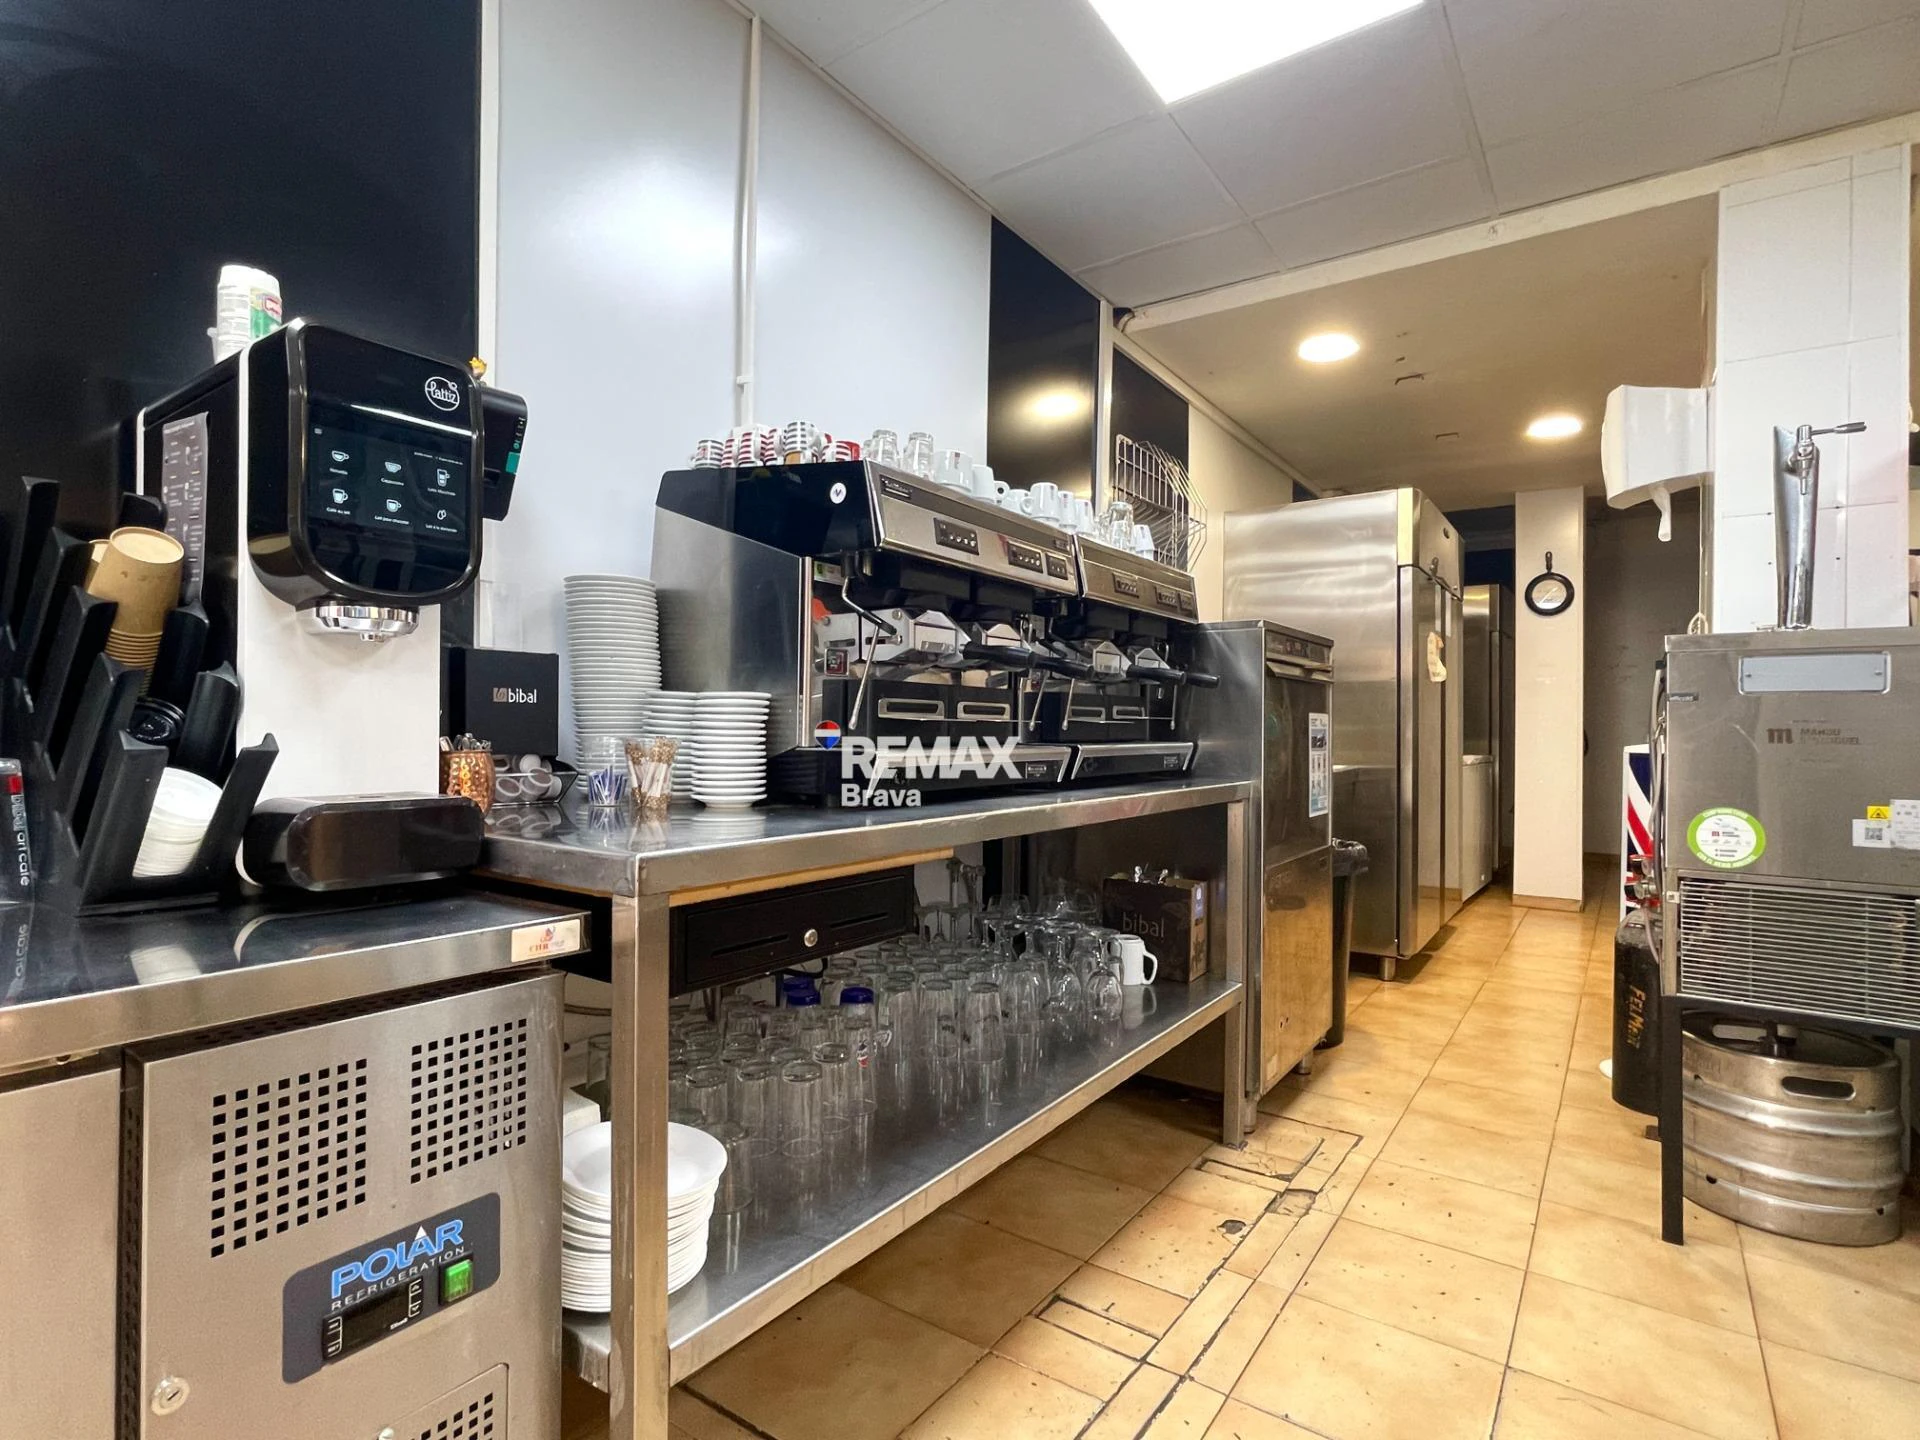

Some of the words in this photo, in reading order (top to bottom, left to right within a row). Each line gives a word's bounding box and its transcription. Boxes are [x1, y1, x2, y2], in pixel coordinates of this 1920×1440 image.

[508, 687, 537, 703] bibal
[1121, 911, 1165, 938] bibal
[331, 1219, 464, 1300] POLAR
[331, 1246, 465, 1311] REFRIGERATION
